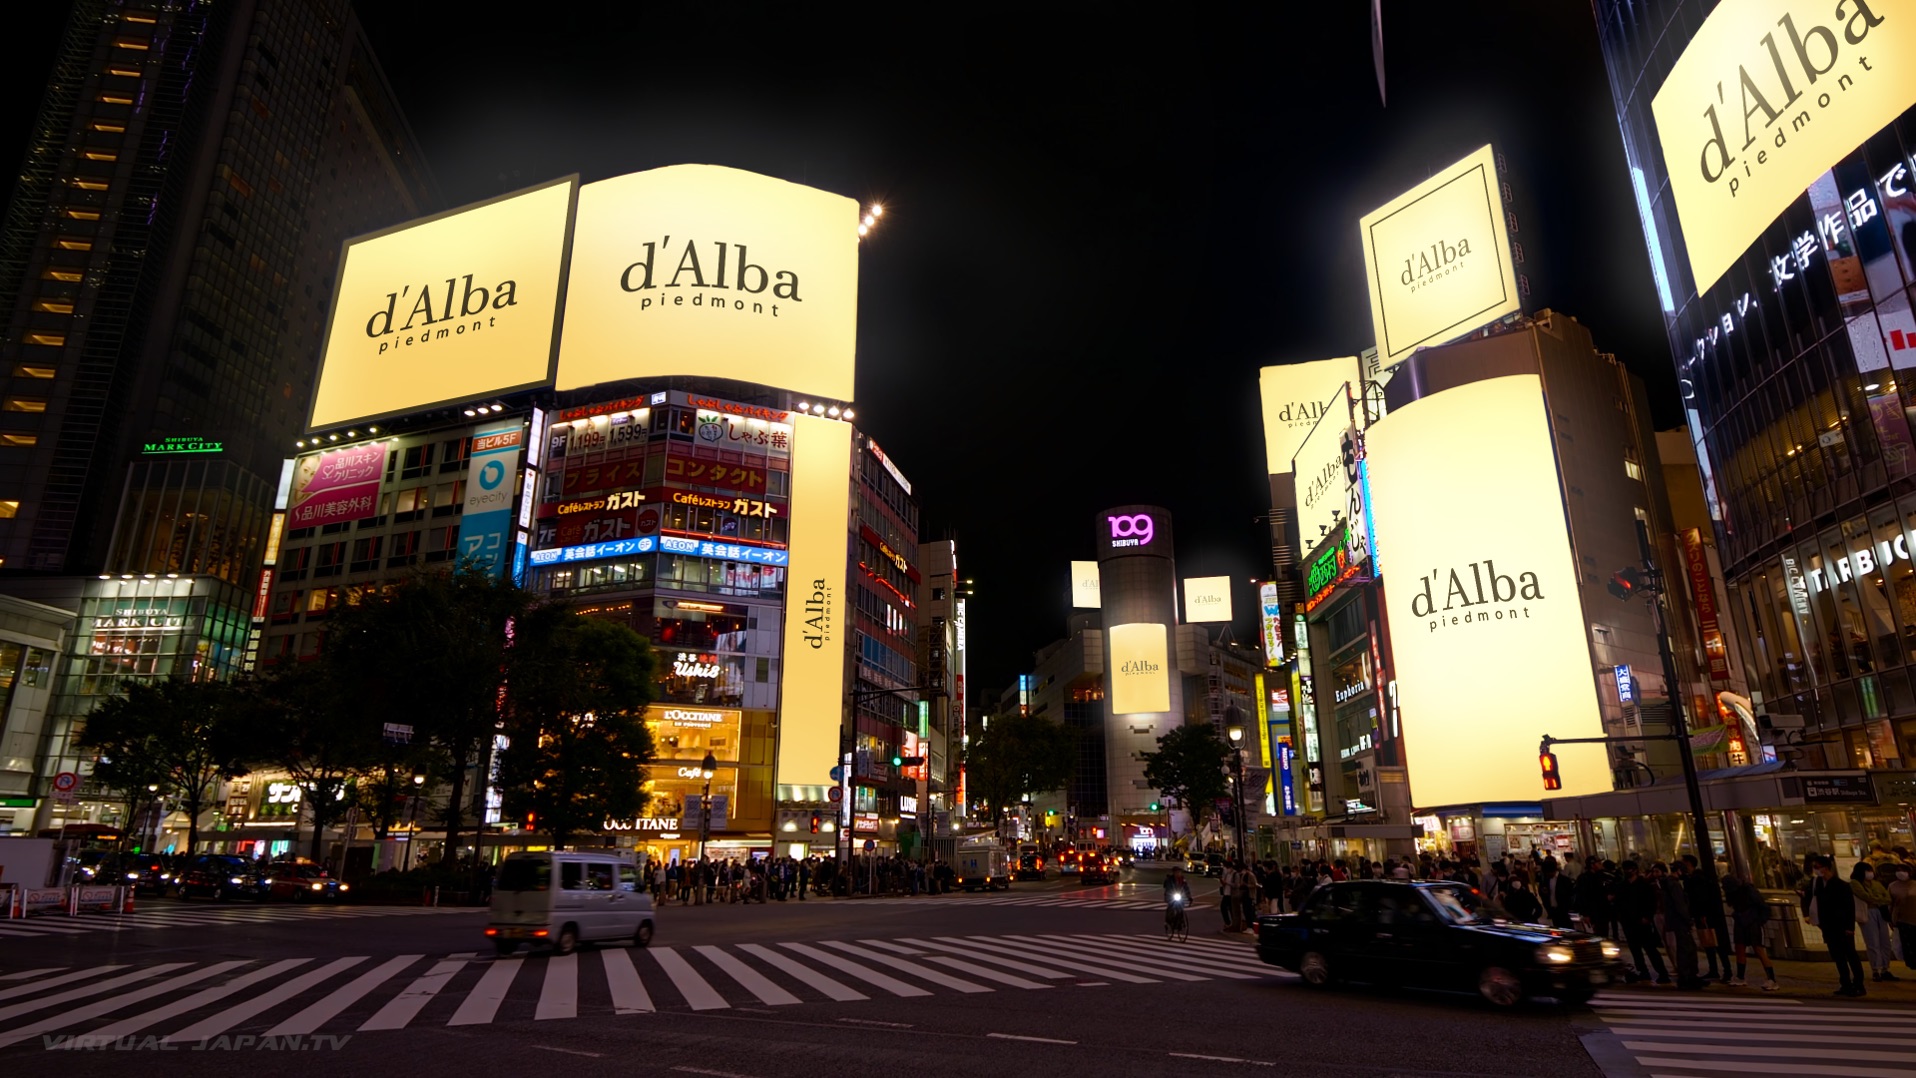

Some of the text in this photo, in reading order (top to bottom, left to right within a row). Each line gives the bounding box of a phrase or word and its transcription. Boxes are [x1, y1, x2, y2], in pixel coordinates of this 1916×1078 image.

[1700, 0, 1885, 183] d'Alba
[1729, 56, 1872, 197] piedmont
[620, 235, 802, 302] d'Alba
[1401, 238, 1472, 286] d'Alba
[1410, 261, 1464, 294] piedmont
[365, 274, 518, 339] d'Alba
[641, 292, 779, 318] piedmont
[378, 316, 496, 355] piedmont
[560, 395, 645, 420] しゃぶしゃぶバイキング
[687, 393, 789, 421] しゃぶしゃぶバイキング
[143, 441, 223, 451] MARK CITY
[477, 433, 517, 450] 当ビル5F
[551, 435, 567, 448] 9F
[729, 423, 788, 449] しゃぶ葉
[335, 451, 382, 470] 品川スキン
[333, 465, 374, 483] クリニック
[667, 458, 763, 488] コンタクト
[301, 495, 373, 521] 品川美容外科
[469, 490, 508, 507] eyecity
[606, 490, 646, 511] ガスト
[732, 498, 778, 519] ガスト
[538, 528, 557, 543] 7F
[582, 517, 631, 543] ガスト
[1108, 514, 1153, 545] 109
[564, 541, 636, 561] 英会話イーオン
[664, 540, 695, 552] AEON
[701, 542, 786, 563] 英会話イーオン
[1112, 538, 1139, 548] SHIBUYA
[534, 551, 558, 563] AEON
[1411, 559, 1545, 618] d'Alba
[1785, 558, 1809, 614] BIC CAMERA
[1194, 594, 1222, 605] d'Alba
[802, 578, 826, 650] d'Alba
[824, 587, 832, 641] piedmont
[1429, 607, 1530, 633] piedmont
[673, 661, 721, 679] Ushi8
[1121, 660, 1159, 674] d'Alba
[1335, 681, 1365, 703] Euphoria
[664, 709, 723, 722] L'OCCITANE
[678, 767, 702, 780] Café
[900, 795, 917, 813] LUSH
